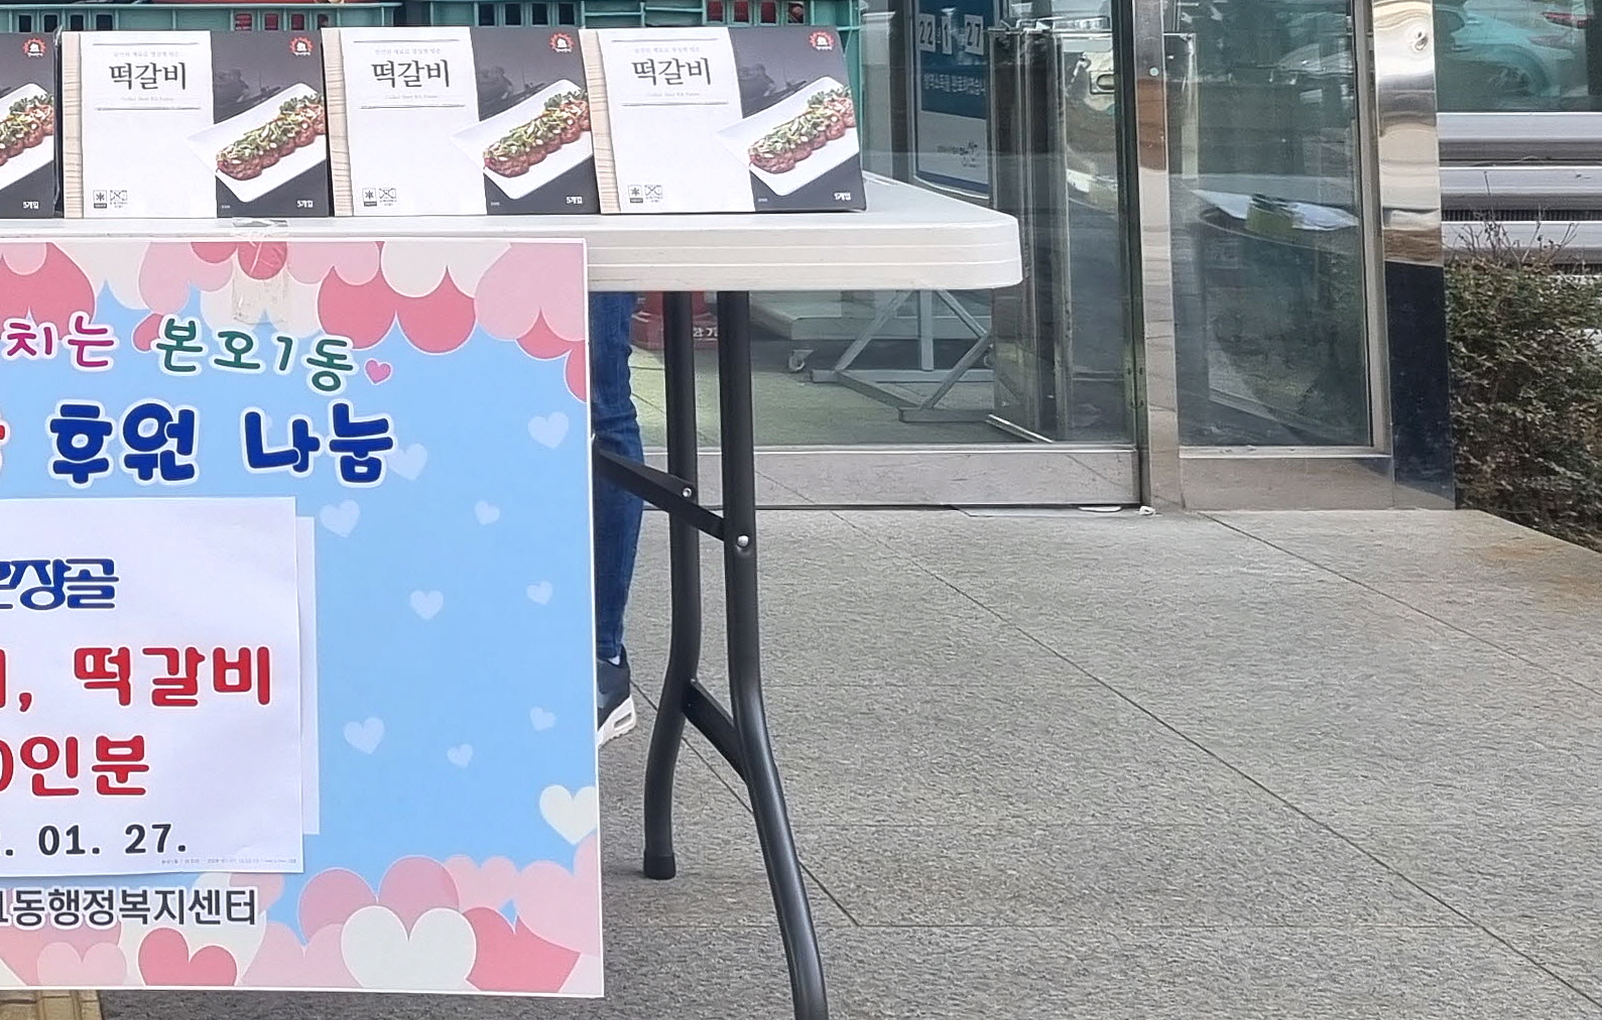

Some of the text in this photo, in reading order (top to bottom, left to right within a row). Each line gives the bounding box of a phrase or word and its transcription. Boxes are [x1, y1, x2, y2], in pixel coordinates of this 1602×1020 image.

[966, 22, 981, 48] 27
[109, 60, 187, 92] 떡갈비
[371, 58, 450, 90] 떡갈비
[631, 57, 711, 86] 떡갈비
[155, 317, 355, 392] 본오1동
[49, 402, 195, 484] 후원
[244, 402, 394, 484] 나눔
[74, 646, 271, 707] 떡갈비
[38, 823, 100, 855] 01.
[125, 823, 187, 855] 27.
